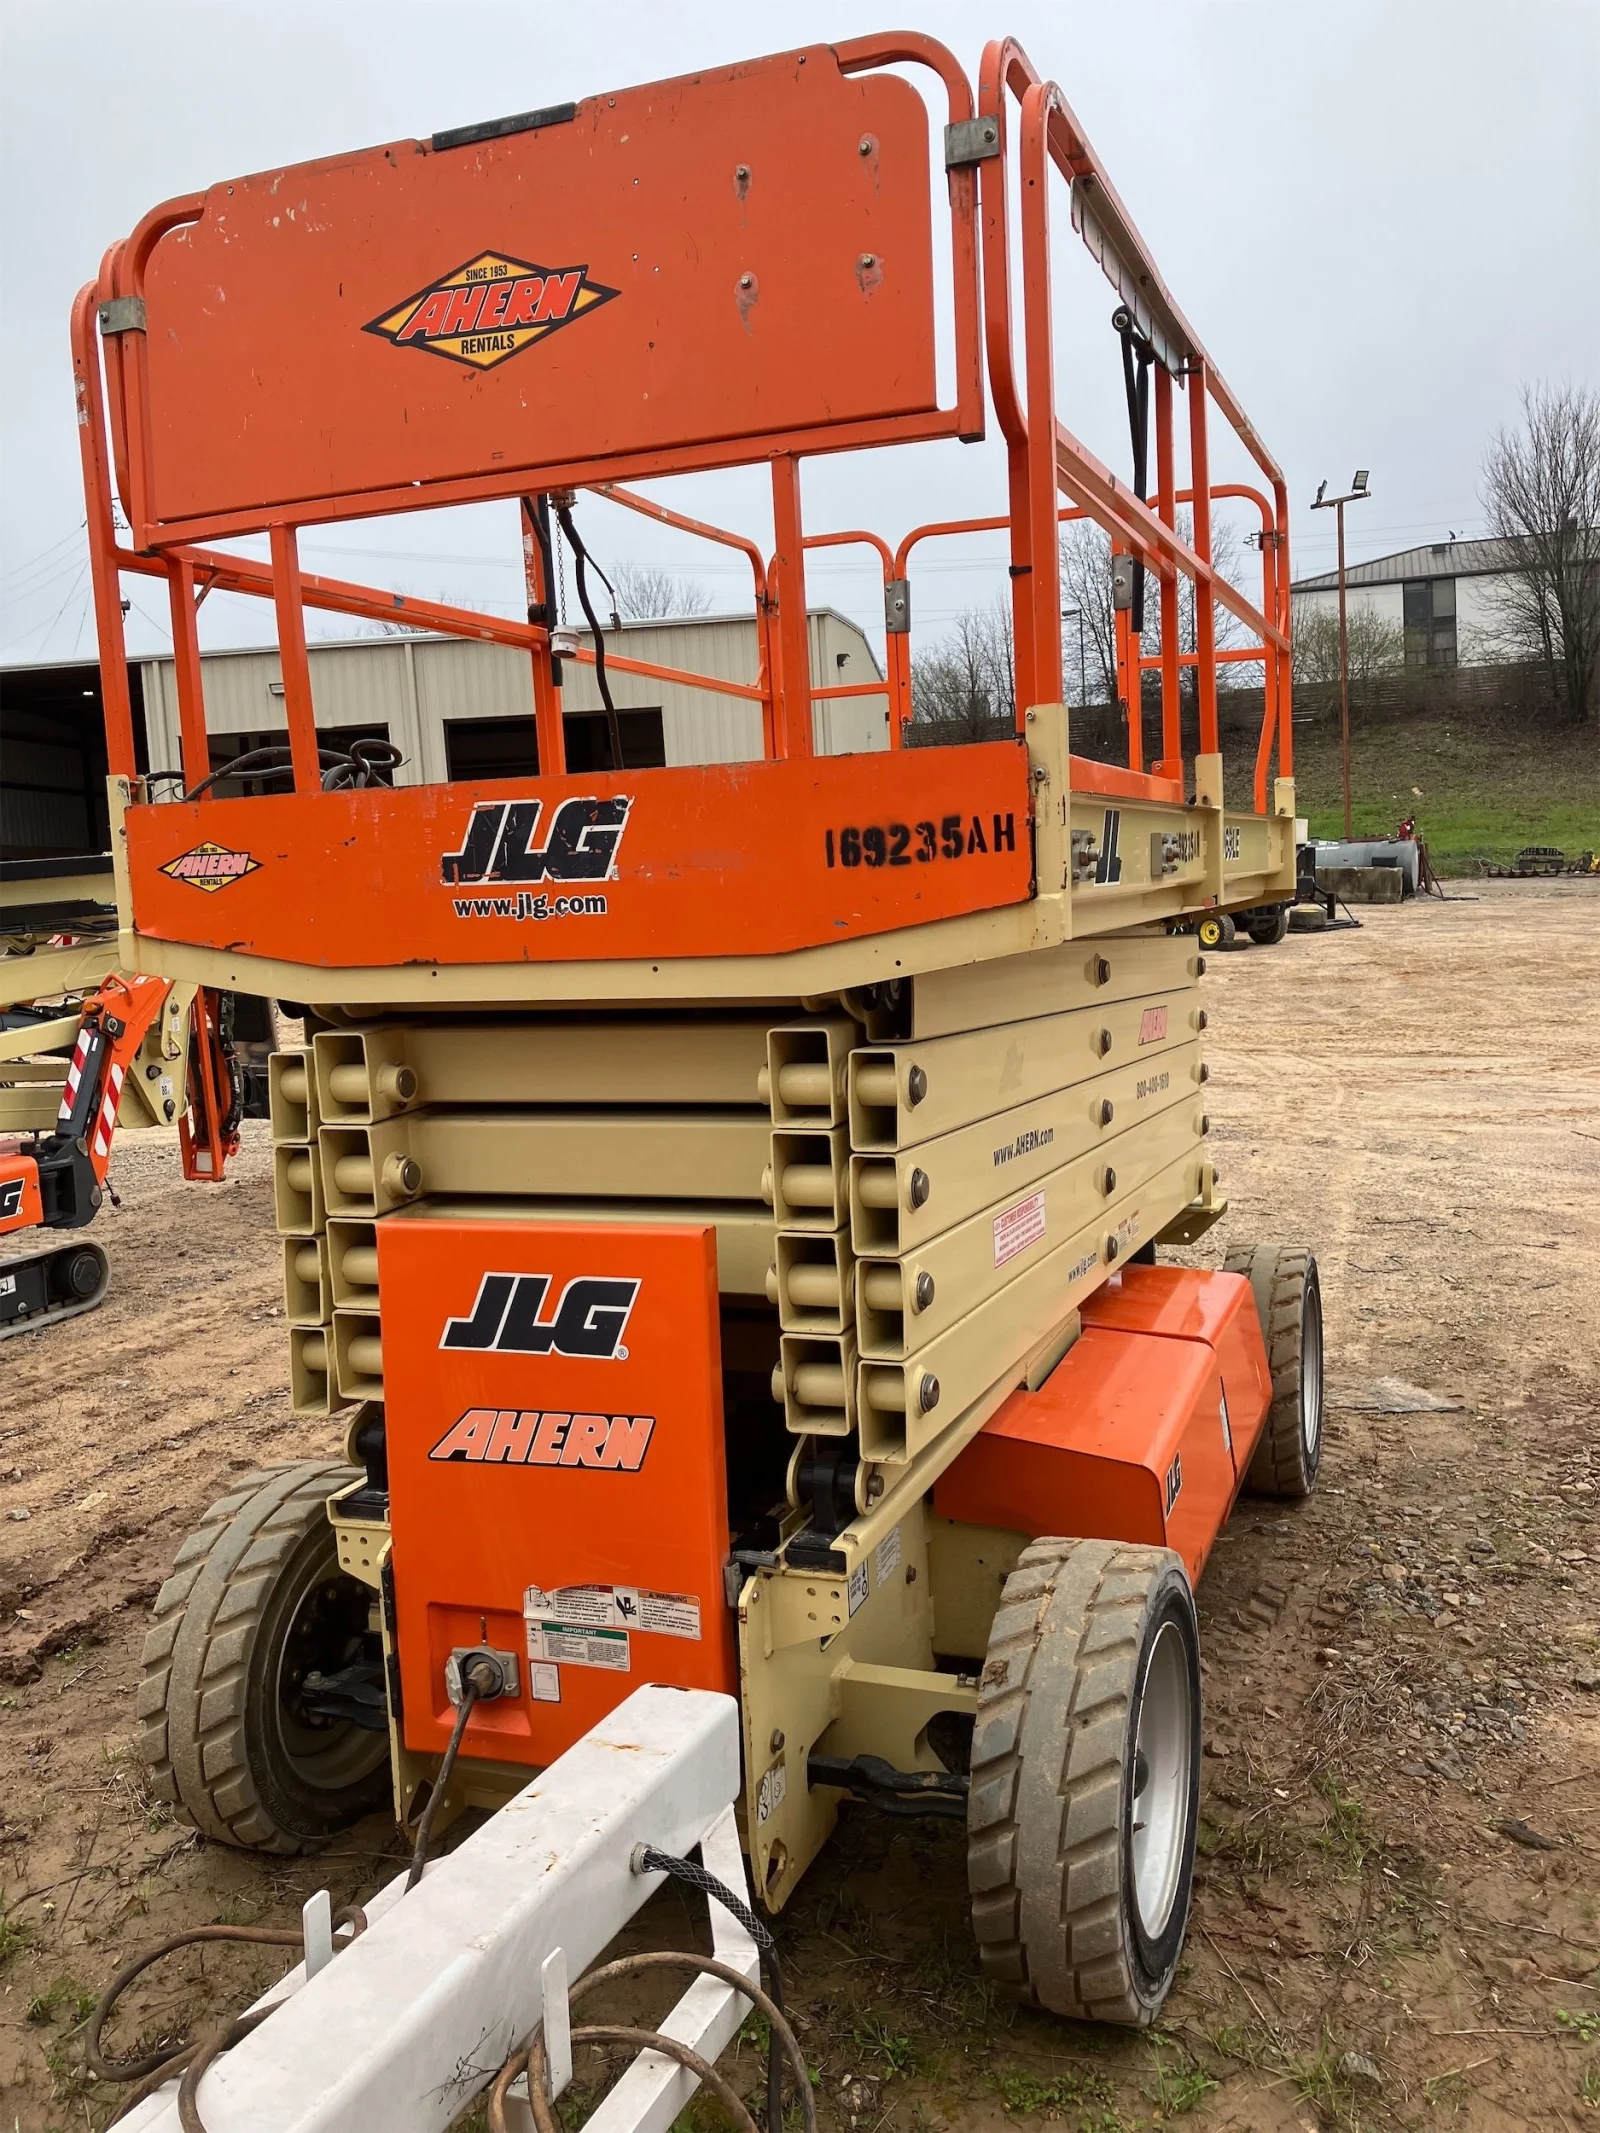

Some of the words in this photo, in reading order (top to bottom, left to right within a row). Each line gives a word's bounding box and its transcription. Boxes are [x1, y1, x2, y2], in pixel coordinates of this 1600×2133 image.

[466, 267, 487, 281] SINCE
[490, 264, 508, 278] 1953
[396, 271, 581, 340] AHERN
[461, 333, 515, 354] RENTALS
[440, 795, 635, 886] JLG
[825, 812, 1016, 868] 169235AH
[170, 853, 249, 877] AHERN
[199, 878, 223, 886] RENTALS
[453, 892, 607, 922] www.jlg.com
[438, 1271, 642, 1360] JLG
[430, 1409, 655, 1469] AHERN
[1166, 1449, 1183, 1522] JLG
[656, 1593, 688, 1603] WARNING
[562, 1626, 597, 1636] IMPORTANT
